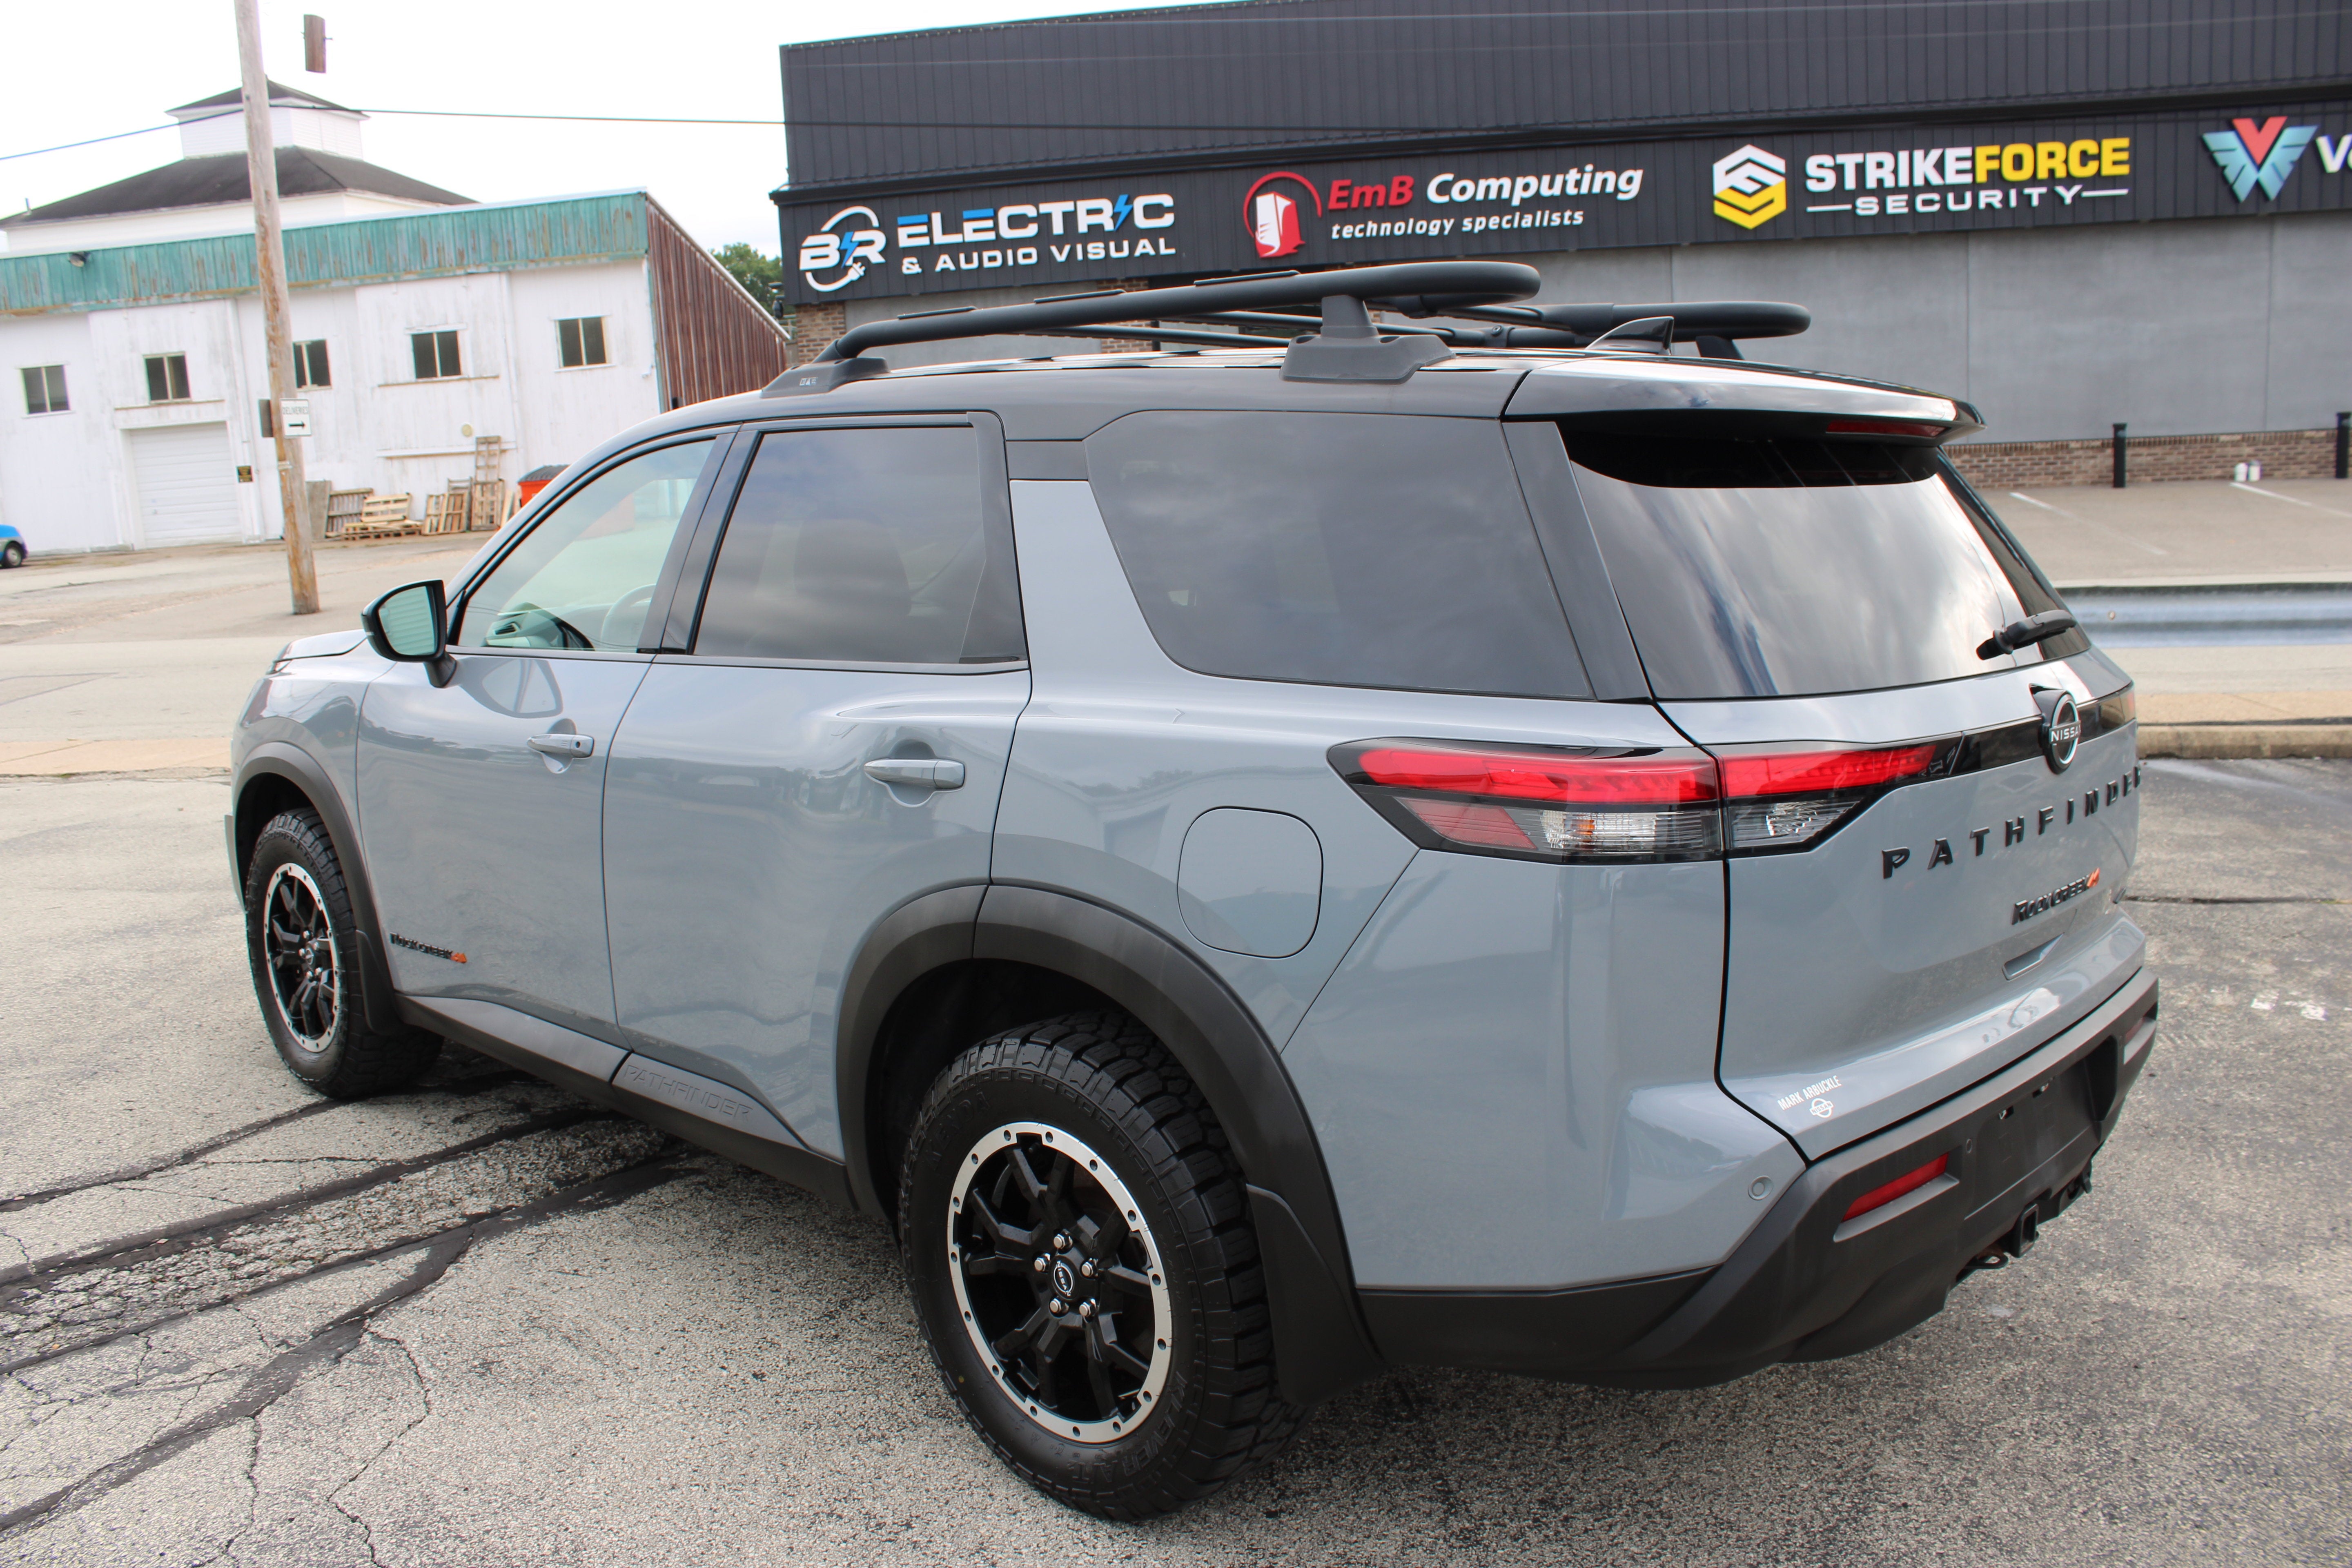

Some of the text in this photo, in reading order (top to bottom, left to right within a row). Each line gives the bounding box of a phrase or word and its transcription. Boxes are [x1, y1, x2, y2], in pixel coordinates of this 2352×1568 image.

[1805, 137, 2130, 192] STRIKEFORCE
[1328, 164, 1644, 209] EmB Computing
[1855, 185, 2084, 216] SECURITY
[1331, 209, 1584, 239] technology specialists
[901, 238, 1176, 275] & AUDIO VISUAL
[624, 1065, 753, 1122] PATHFINDER
[1777, 1075, 1842, 1111] MARK ARBUCKLE
[1812, 1101, 1831, 1114] NISSAN
